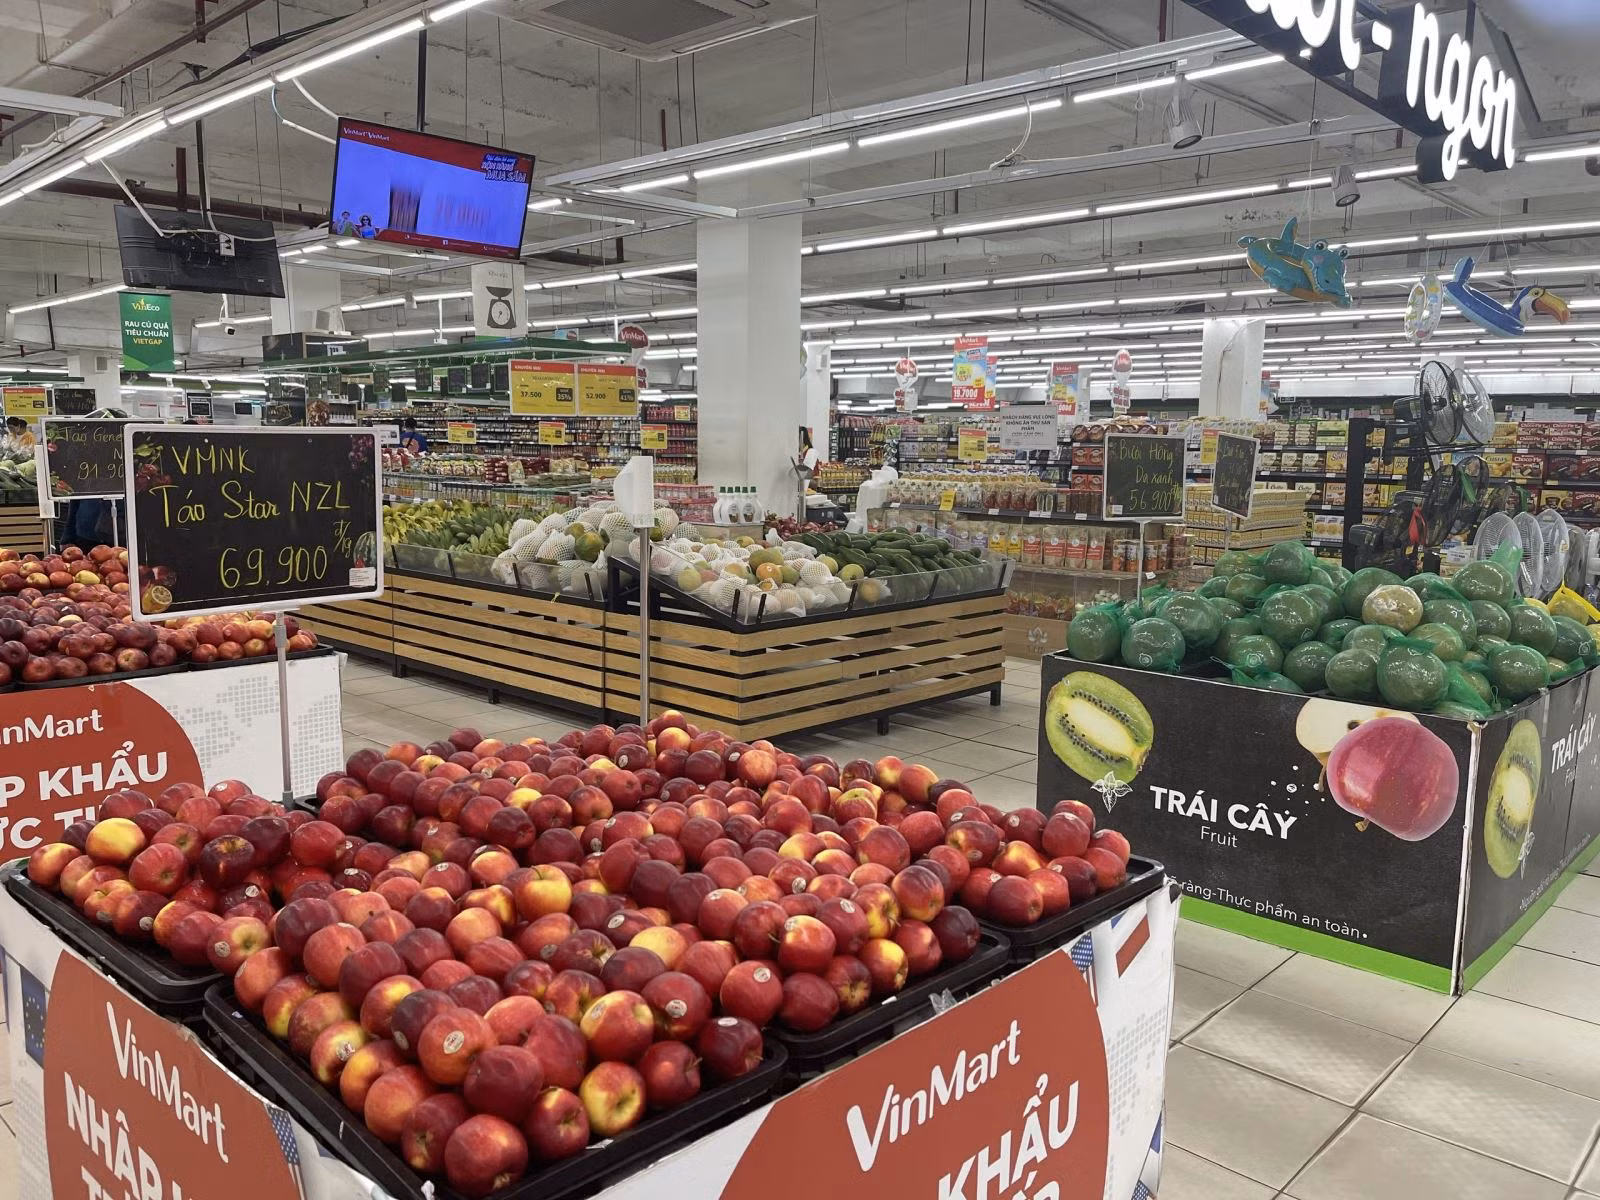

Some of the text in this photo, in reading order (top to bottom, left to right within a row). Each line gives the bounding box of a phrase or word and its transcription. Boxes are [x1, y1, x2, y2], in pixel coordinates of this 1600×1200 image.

[1405, 2, 1516, 181] ngon
[131, 299, 160, 311] VinEco
[133, 337, 163, 345] VIETGAP
[621, 330, 646, 342] VinMart
[585, 392, 607, 400] 52.900
[171, 444, 255, 476] VMNK
[148, 479, 351, 528] Táo Star NZL
[0, 708, 104, 746] nMart
[1551, 723, 1577, 774] TRÁI
[38, 740, 168, 801] KHẨU
[1149, 784, 1298, 840] TRÁI CÂY
[1200, 825, 1239, 848] Fruit
[1254, 899, 1298, 922] phẩm
[1301, 914, 1321, 929] an
[1324, 919, 1361, 940] toàn
[106, 1001, 230, 1164] VinMart
[846, 1019, 1021, 1172] VinMart
